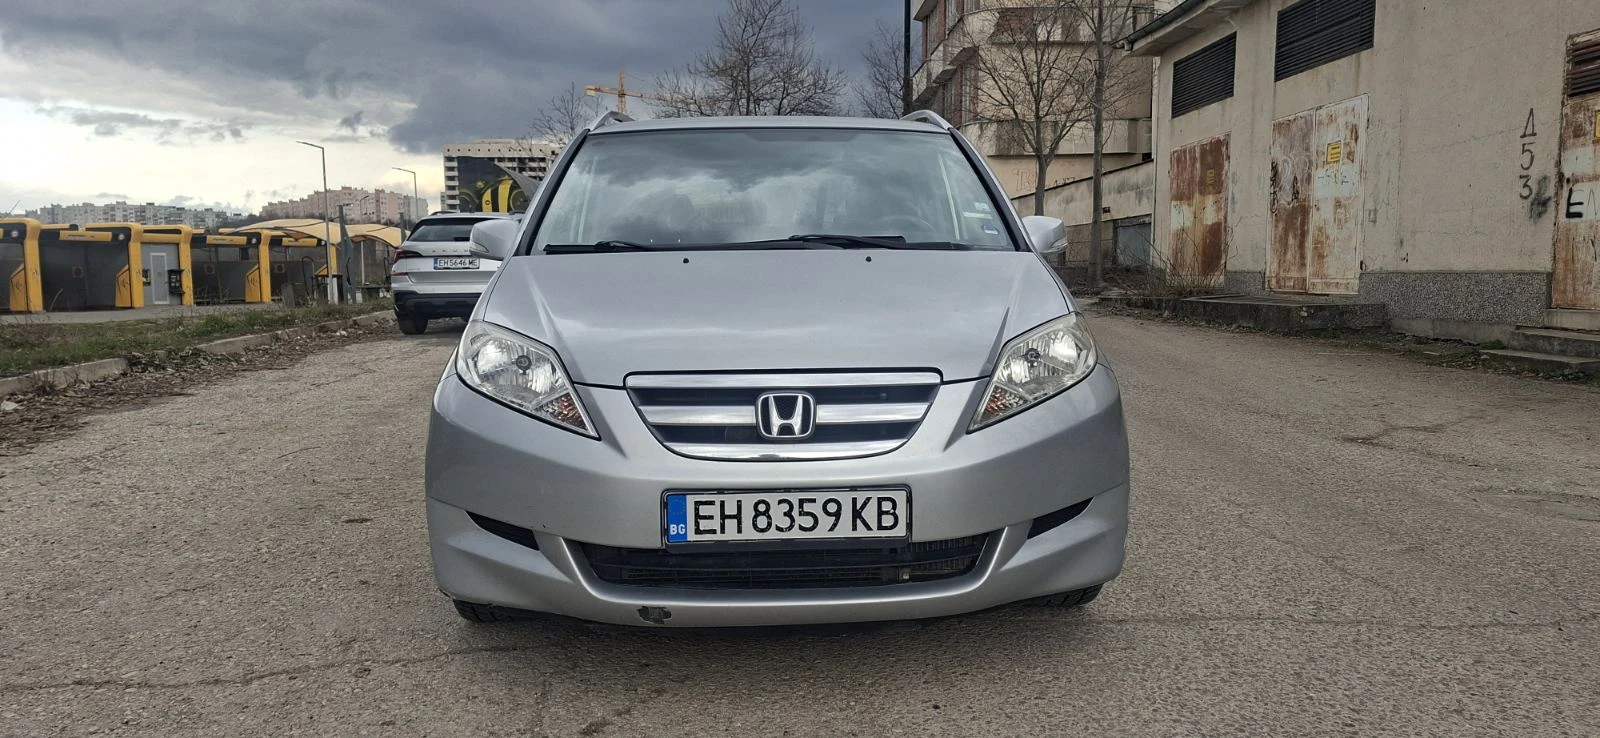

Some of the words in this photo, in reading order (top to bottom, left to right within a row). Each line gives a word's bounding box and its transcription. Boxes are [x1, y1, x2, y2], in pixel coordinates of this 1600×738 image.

[693, 500, 743, 535] EH
[751, 498, 843, 533] 8359
[850, 496, 900, 532] KB
[669, 524, 686, 535] BG
